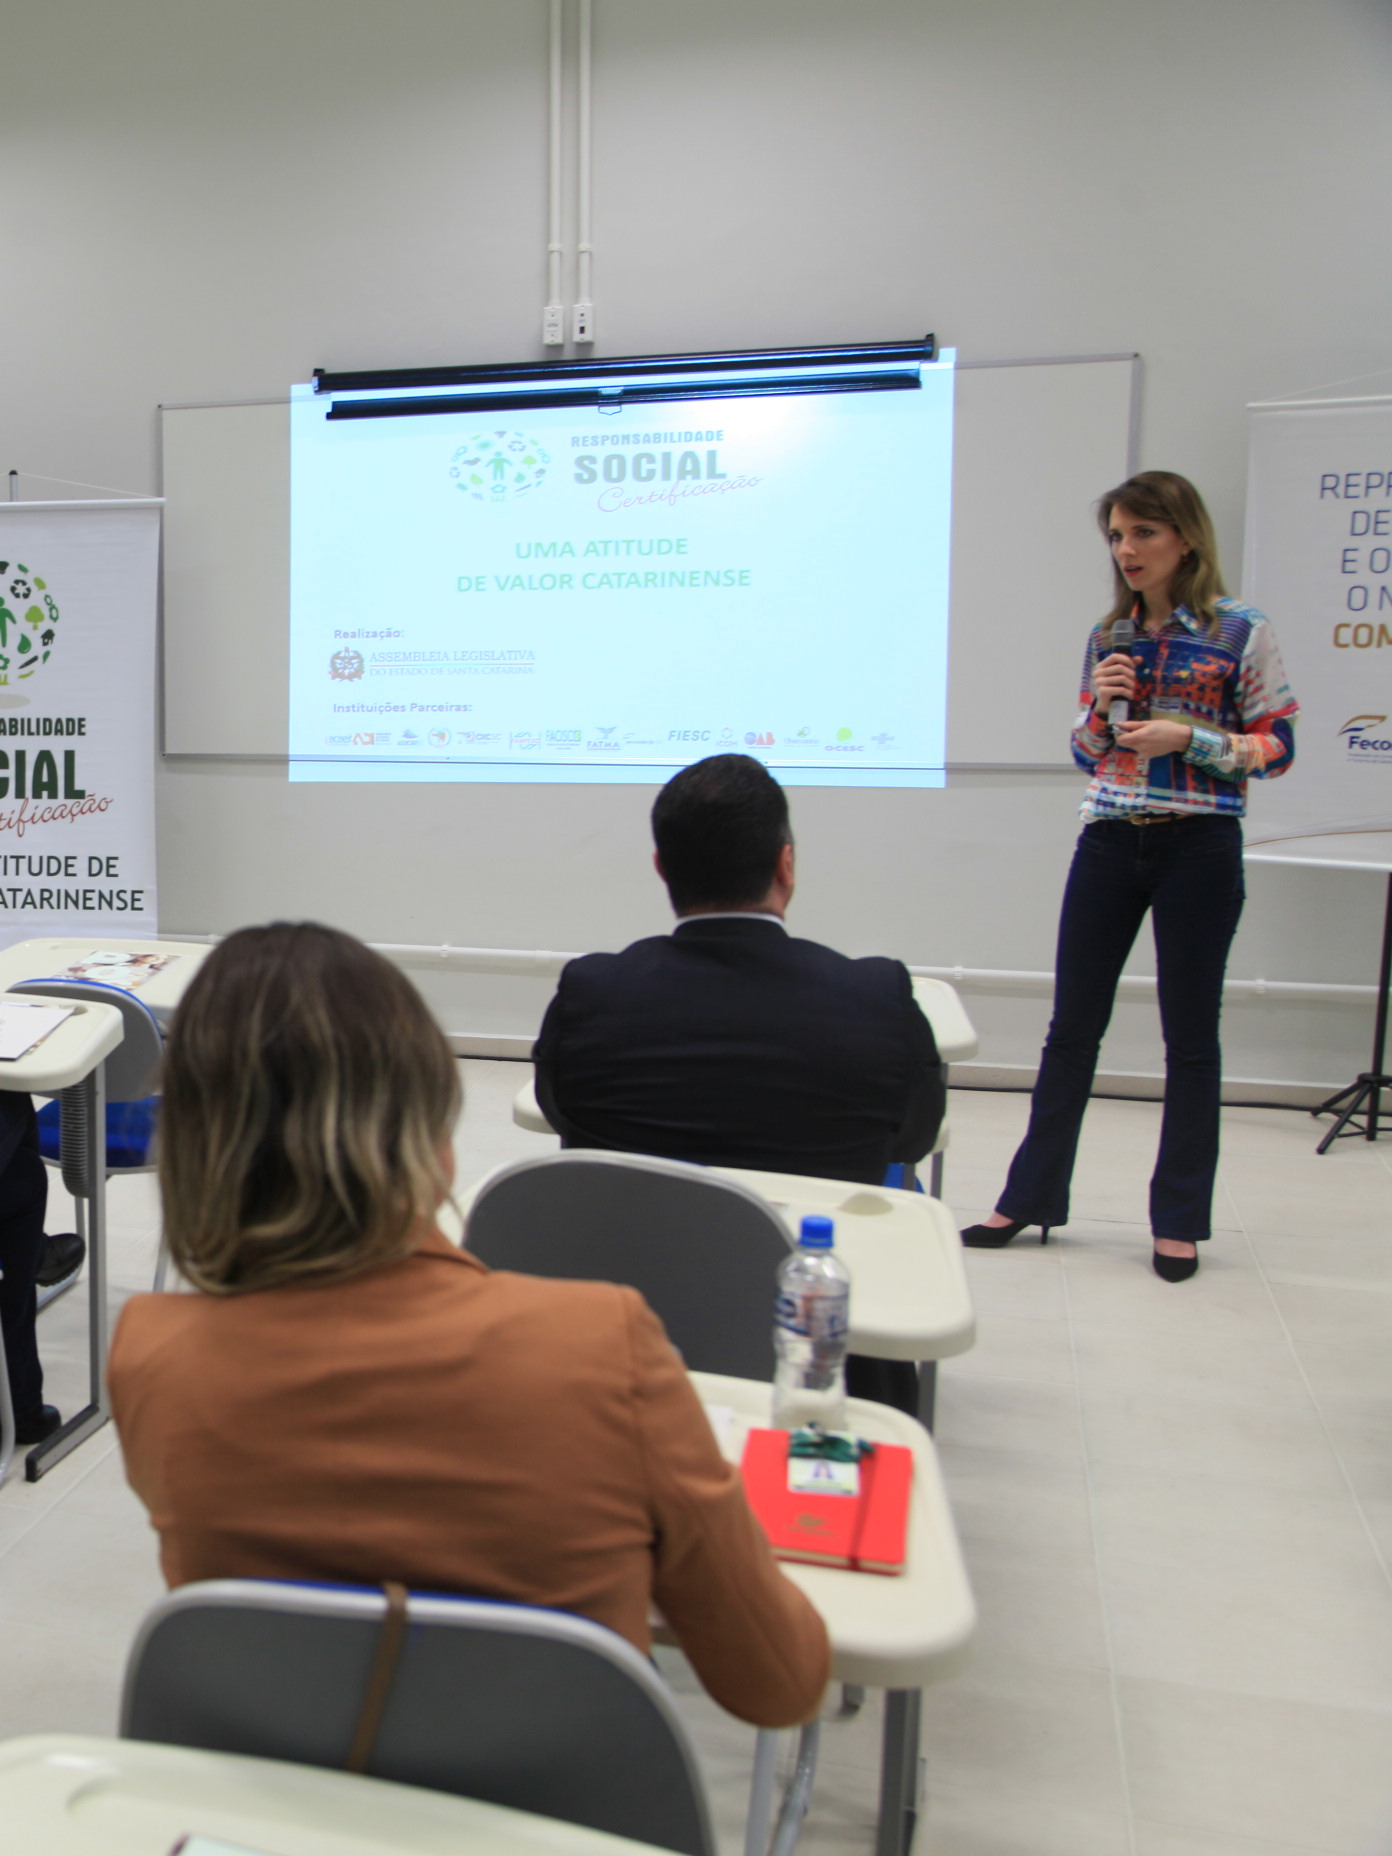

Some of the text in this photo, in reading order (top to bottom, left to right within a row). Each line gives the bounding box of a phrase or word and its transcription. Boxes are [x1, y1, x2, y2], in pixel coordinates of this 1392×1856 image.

[571, 430, 724, 447] RESPONSABILIDADE
[574, 450, 727, 485] SOCIAL
[597, 475, 762, 513] Certificação
[515, 538, 688, 559] UMA ATITUDE
[1341, 548, 1359, 574] E
[456, 569, 752, 592] DE VALOR CATARINENSE
[334, 628, 404, 640] Realização:
[370, 650, 535, 662] ASSEMBLEIA LEGISLATIVA
[389, 668, 427, 676] ESTADO
[447, 667, 479, 676] SANTA
[481, 666, 534, 675] CATARINA
[333, 702, 472, 715] Instituições Parceiras:
[668, 730, 711, 742] FIESC
[587, 741, 620, 750] FATMA
[88, 856, 119, 878] DE
